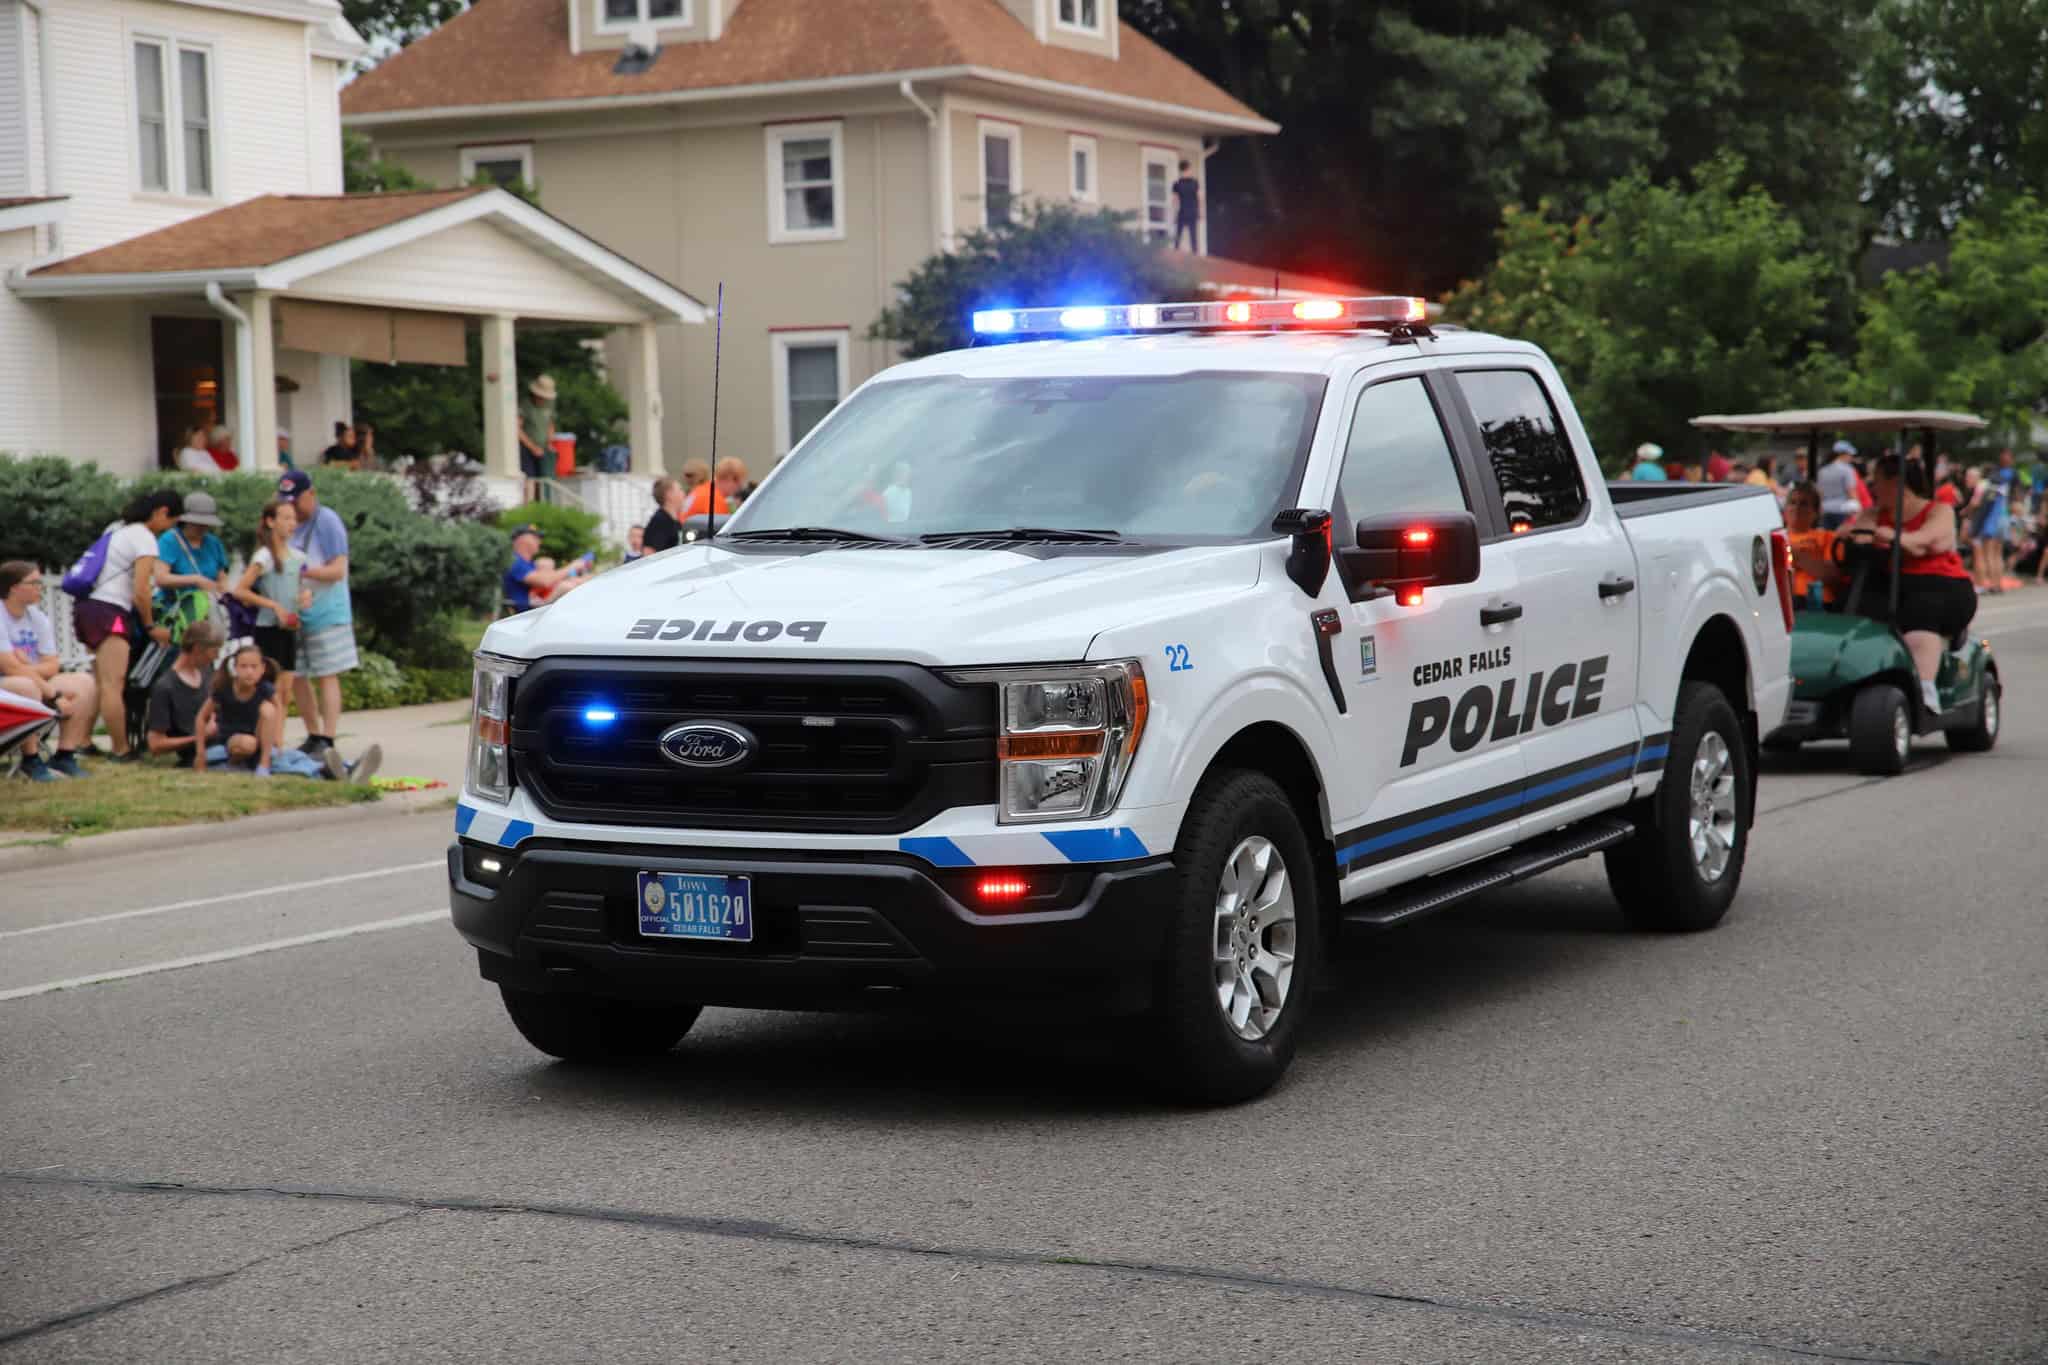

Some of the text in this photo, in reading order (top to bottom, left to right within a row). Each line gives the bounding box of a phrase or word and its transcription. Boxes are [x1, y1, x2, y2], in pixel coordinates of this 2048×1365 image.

[1165, 644, 1193, 672] 22
[1413, 646, 1511, 687] CEDAR FALLS
[1400, 655, 1609, 768] POLICE
[679, 733, 725, 757] Ford
[640, 915, 671, 924] OFFICIAL
[670, 892, 745, 926] 501620
[698, 925, 721, 935] FALLS
